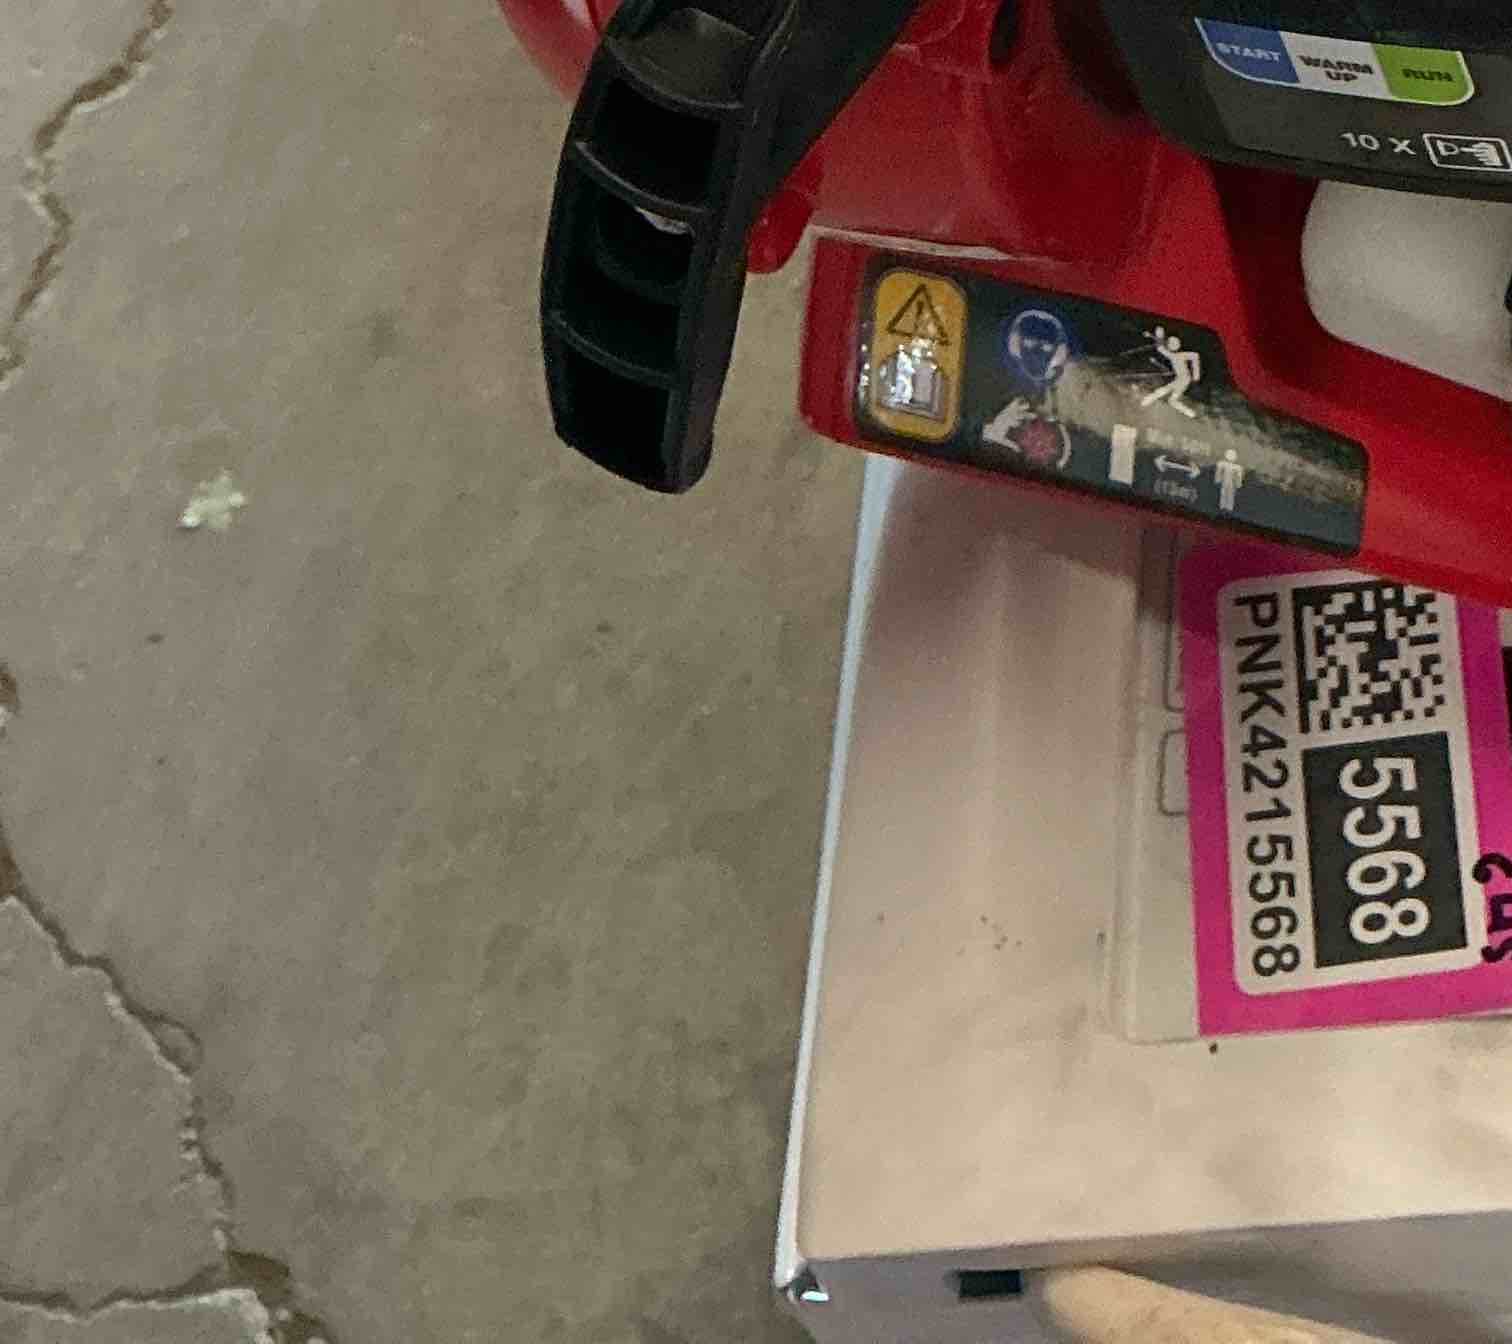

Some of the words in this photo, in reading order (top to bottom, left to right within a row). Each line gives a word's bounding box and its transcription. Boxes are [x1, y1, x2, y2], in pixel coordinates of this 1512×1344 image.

[1215, 42, 1282, 63] START
[1300, 54, 1374, 75] WARM
[1402, 66, 1454, 83] RUN
[1325, 70, 1358, 83] UP
[1340, 132, 1380, 151] 10
[1233, 592, 1300, 978] PNK4215568
[1339, 755, 1430, 946] 5568
